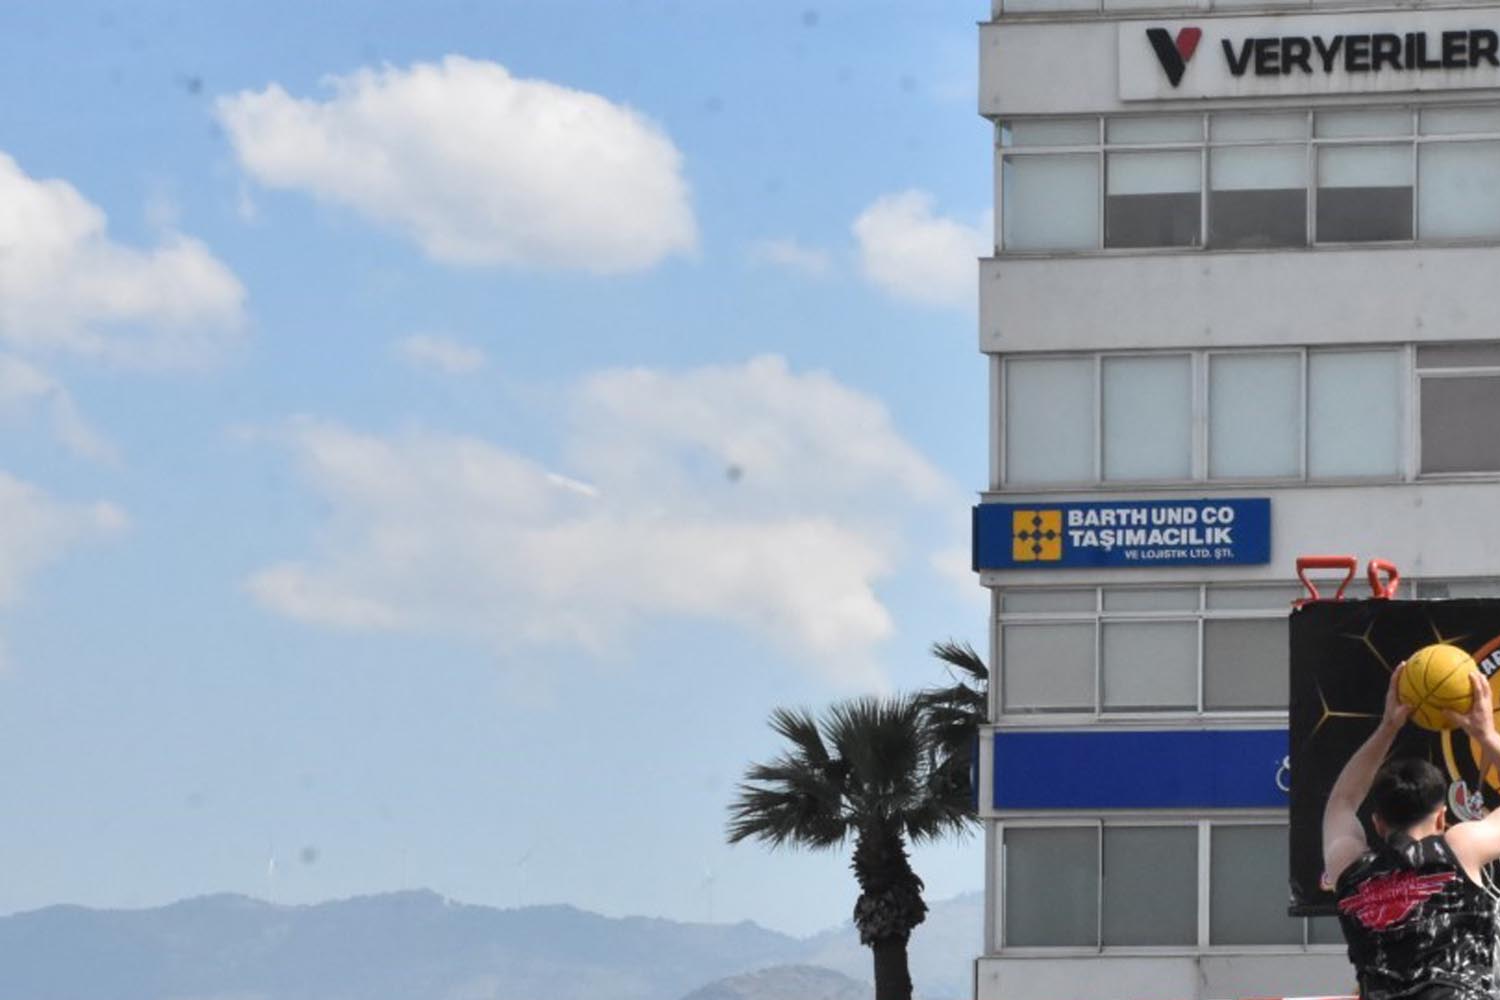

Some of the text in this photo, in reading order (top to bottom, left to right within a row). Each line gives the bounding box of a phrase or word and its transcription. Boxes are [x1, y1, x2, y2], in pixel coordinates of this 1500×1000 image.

[1221, 29, 1500, 77] VERYERILER
[1068, 506, 1235, 526] BARTH UND CO
[1068, 527, 1233, 551] TAŞIMACILIK
[1124, 550, 1139, 559] VE
[1190, 548, 1212, 559] LTD.
